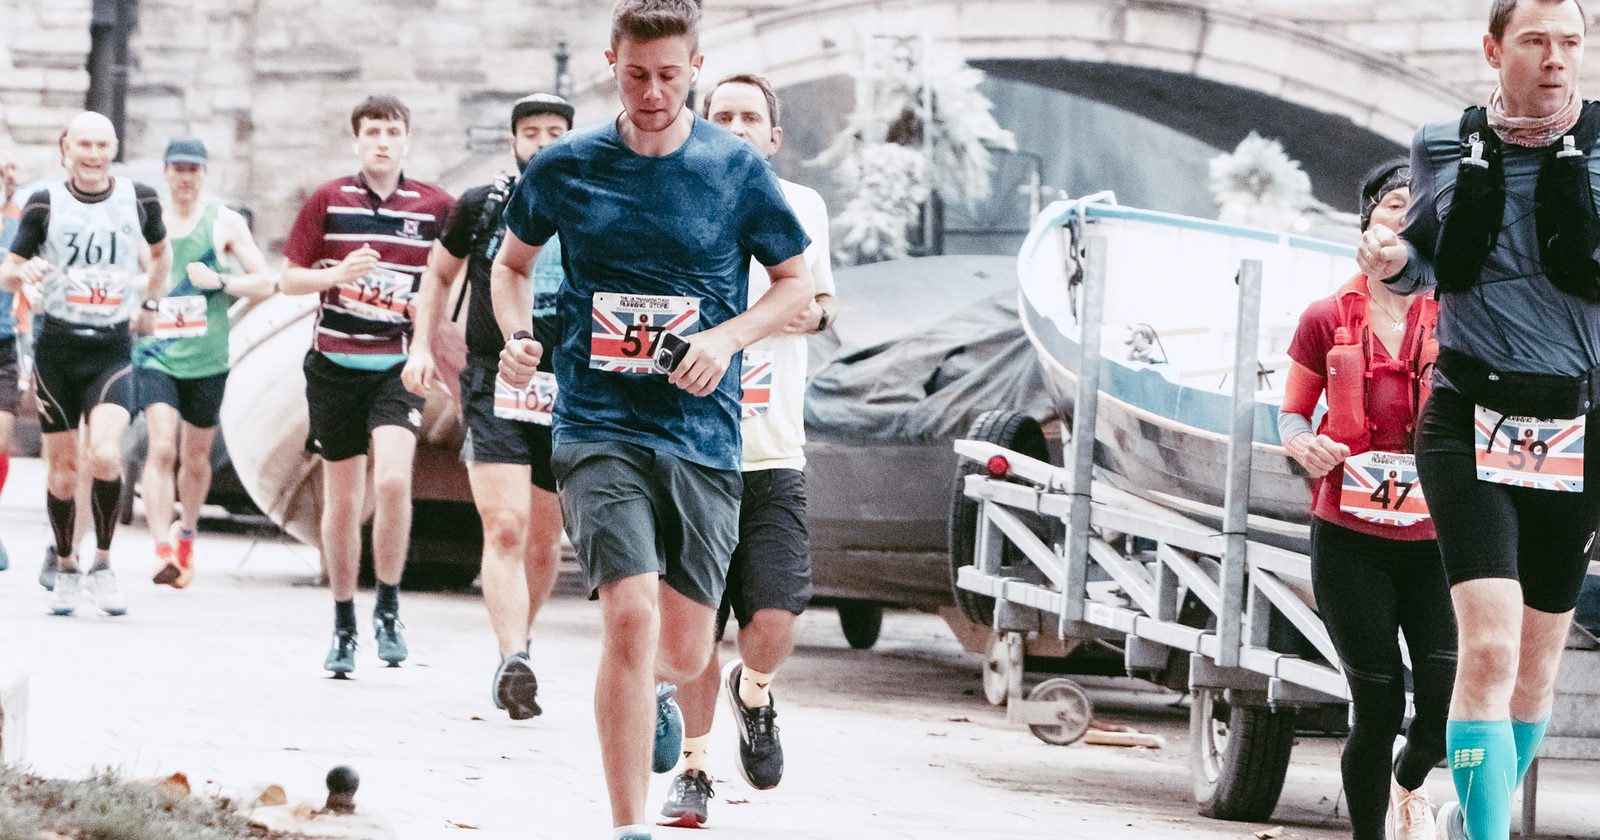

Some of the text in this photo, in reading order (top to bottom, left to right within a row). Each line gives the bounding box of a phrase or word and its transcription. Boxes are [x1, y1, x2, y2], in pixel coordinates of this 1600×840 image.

[63, 231, 116, 267] 361
[358, 284, 394, 310] 124
[620, 300, 646, 308] RUNNING
[175, 313, 185, 328] 8
[621, 324, 667, 357] 57
[513, 391, 552, 413] 102
[1507, 438, 1549, 472] 59
[1369, 480, 1413, 510] 47
